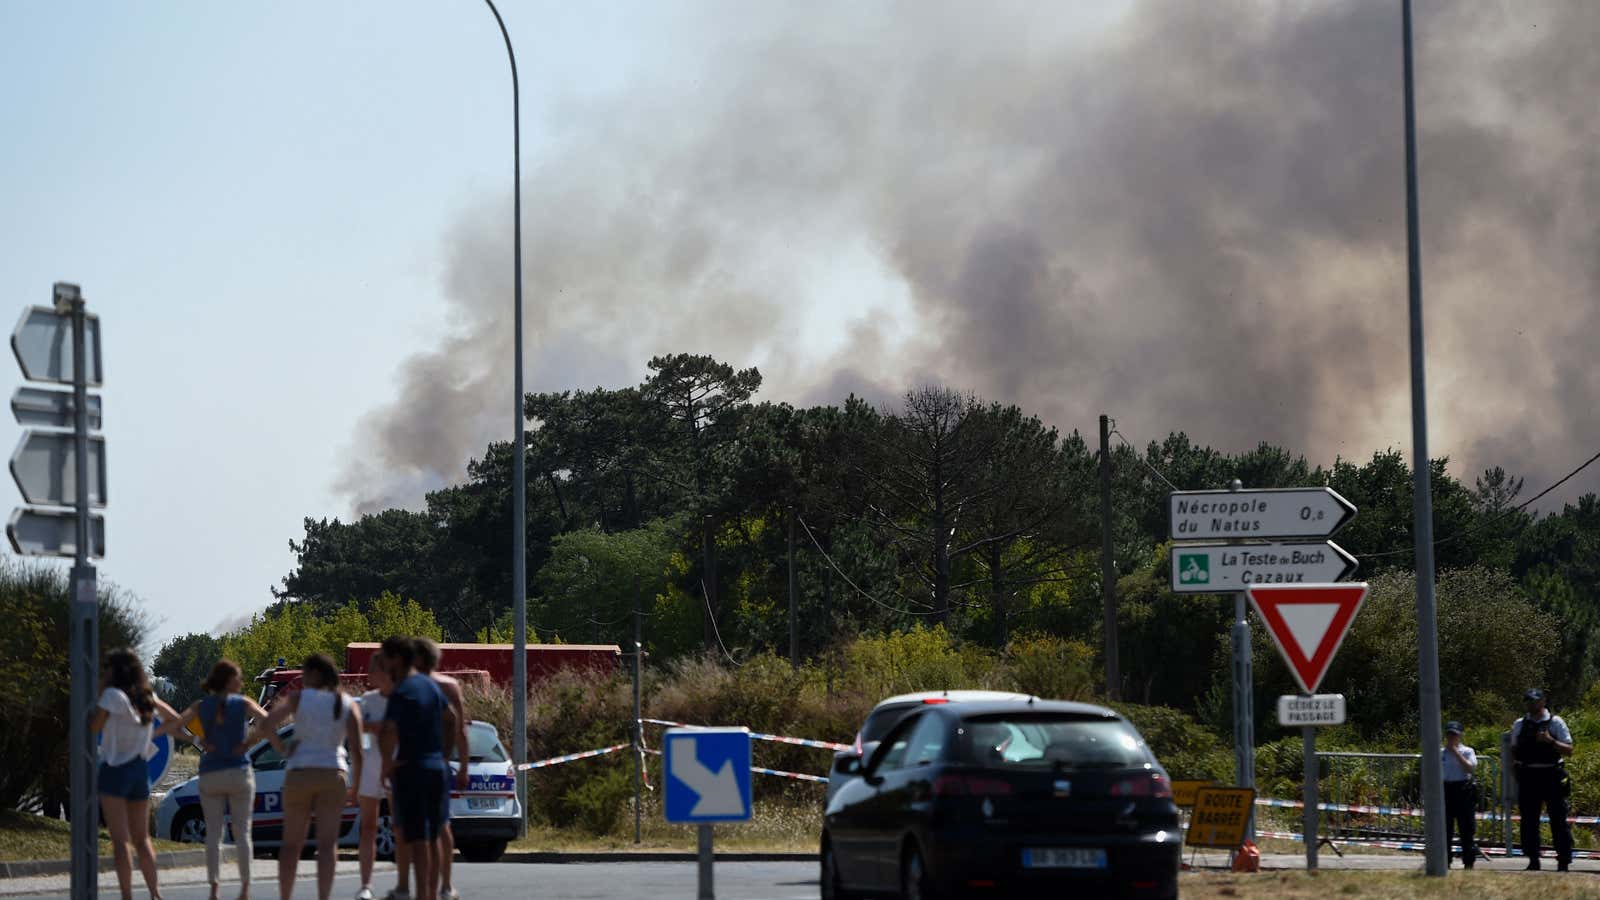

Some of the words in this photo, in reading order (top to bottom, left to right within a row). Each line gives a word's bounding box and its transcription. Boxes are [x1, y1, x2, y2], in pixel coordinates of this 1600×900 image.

[1177, 499, 1267, 516] Nécropole
[1178, 520, 1198, 533] du
[1211, 518, 1260, 532] Natus
[1221, 552, 1237, 566] La
[1242, 551, 1277, 566] Teste
[1292, 550, 1324, 564] Buch
[1241, 570, 1304, 584] Cazaux
[1287, 712, 1336, 721] PASSAGE
[471, 782, 500, 790] POLICE
[1204, 793, 1243, 807] ROUTE
